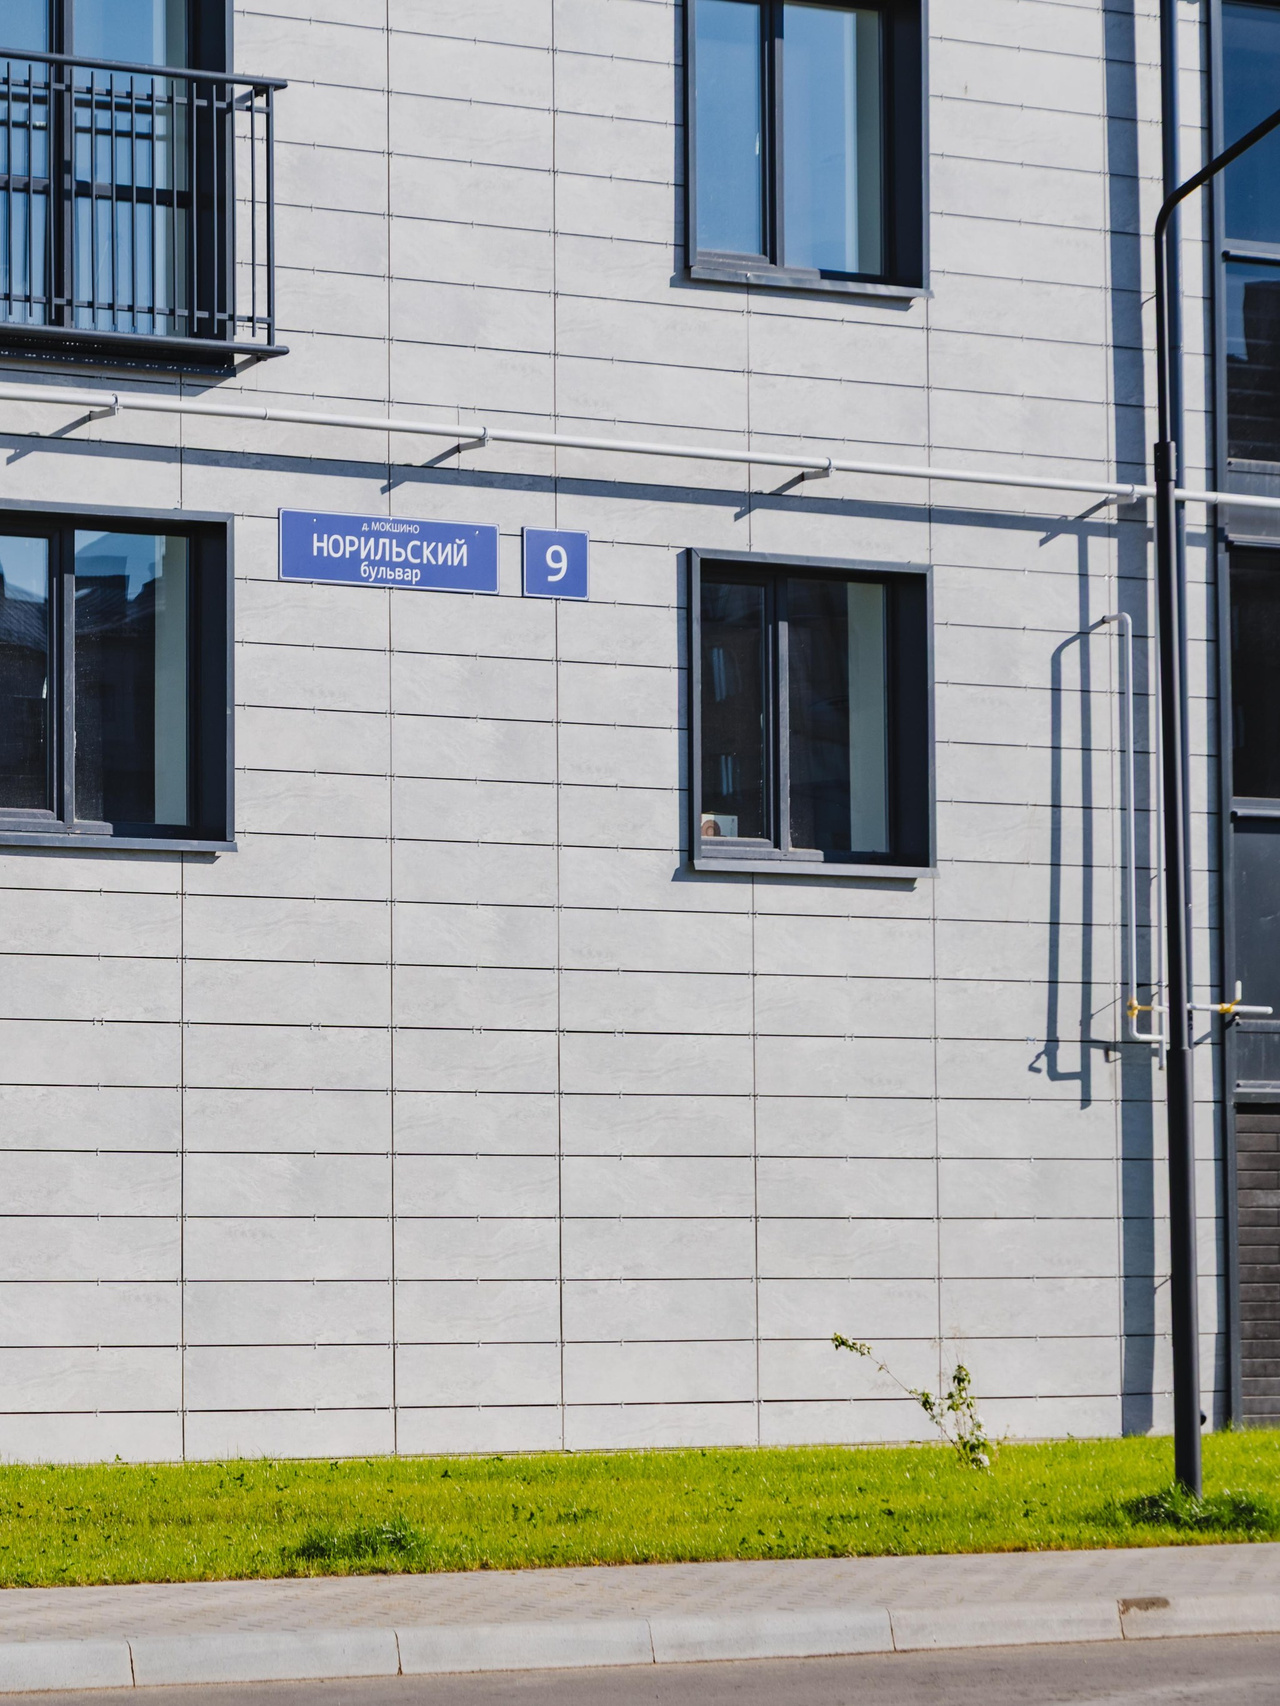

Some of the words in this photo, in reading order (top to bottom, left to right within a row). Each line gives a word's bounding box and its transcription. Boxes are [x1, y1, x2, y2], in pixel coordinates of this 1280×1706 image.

[371, 521, 420, 534] МОКШИНО
[312, 533, 468, 567] НОРИЛЬСКИЙ
[545, 545, 568, 582] 9
[360, 561, 421, 584] бульвар
